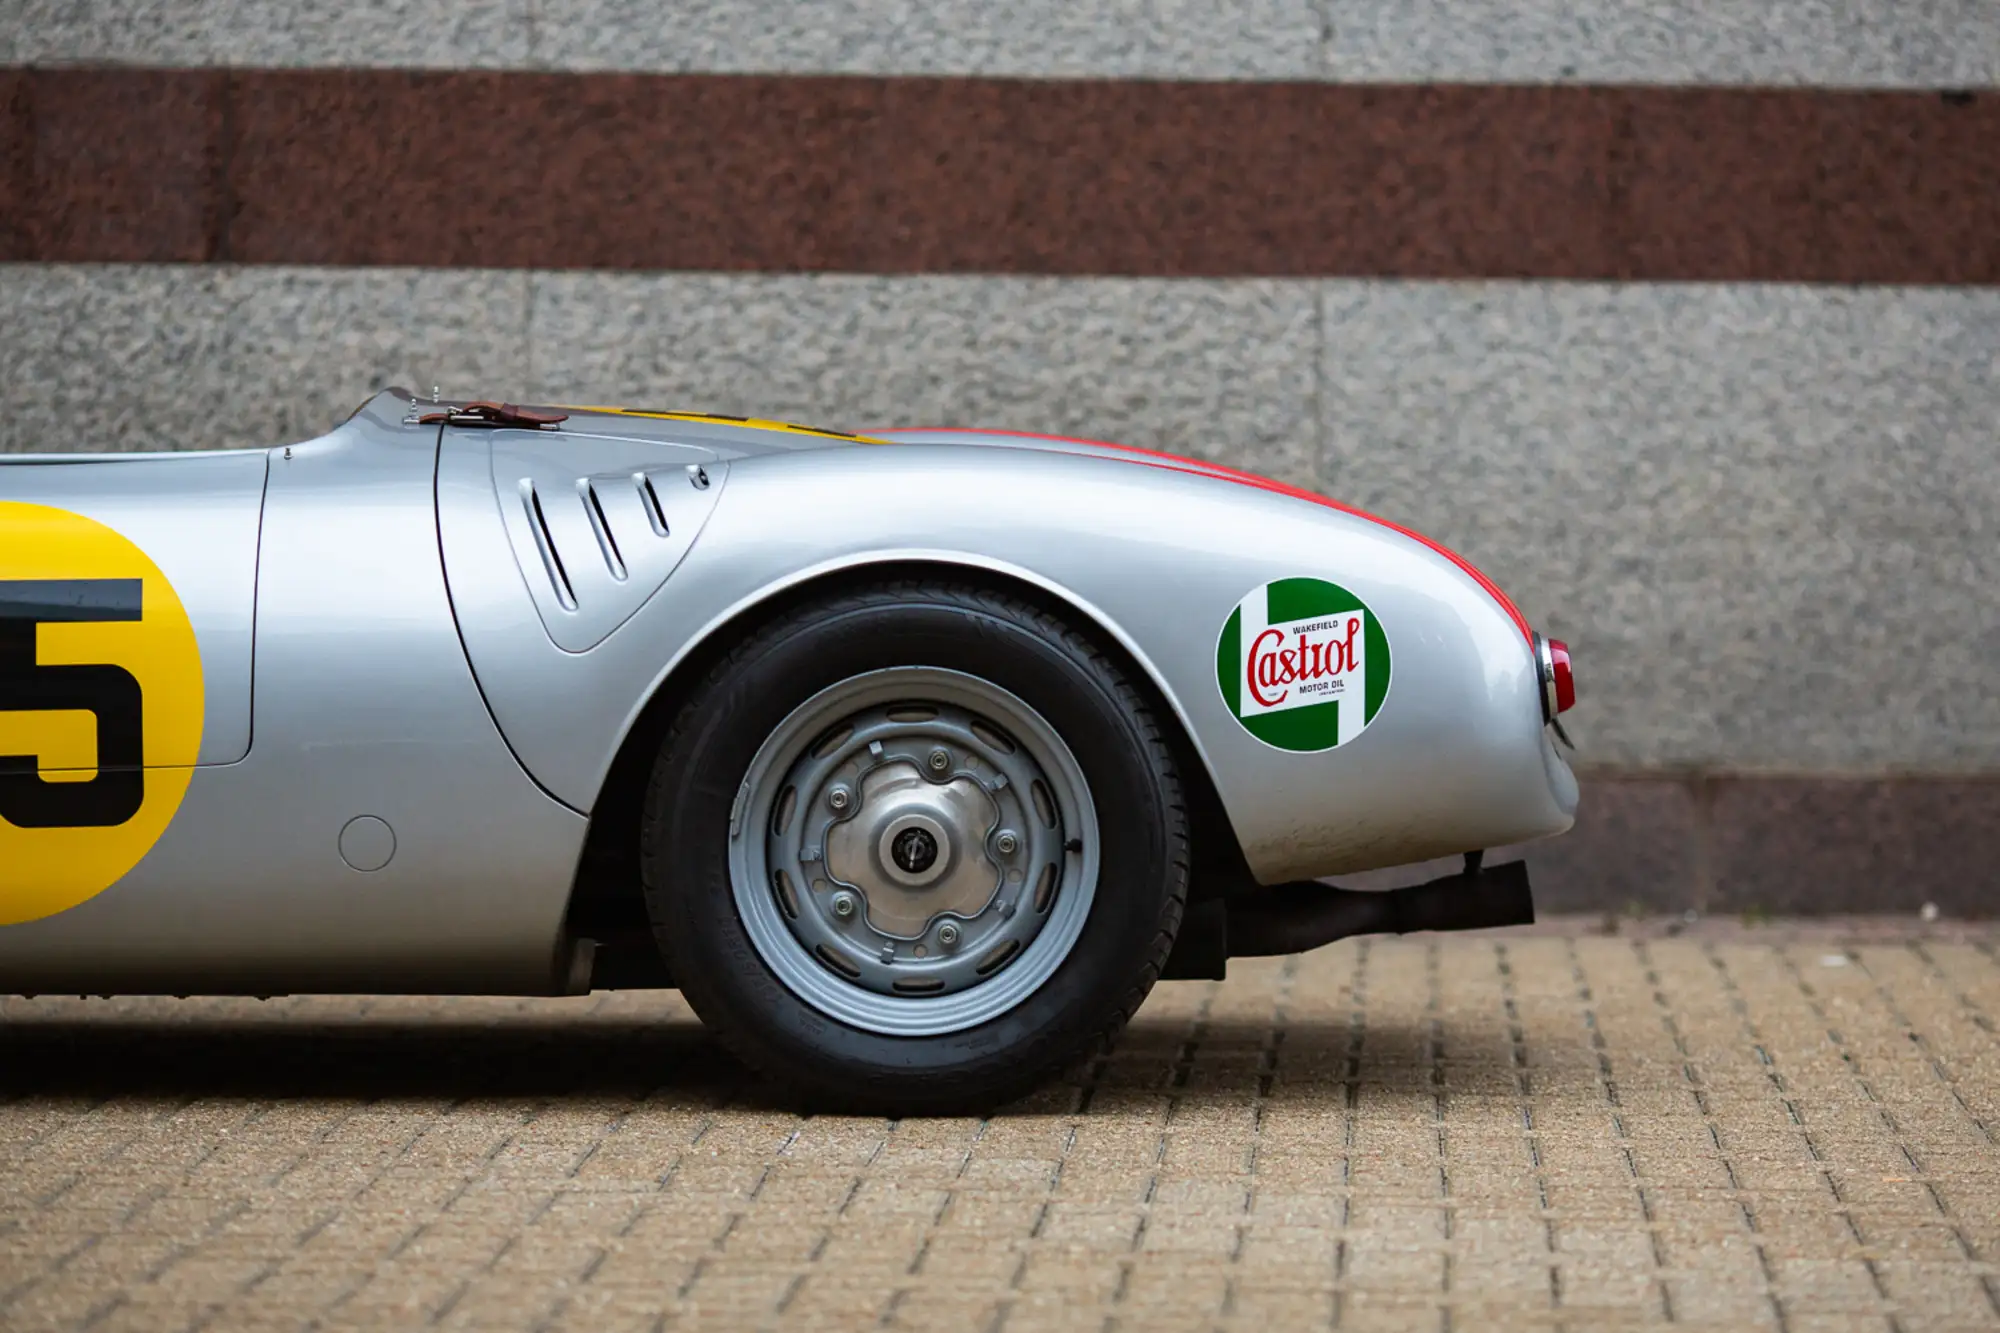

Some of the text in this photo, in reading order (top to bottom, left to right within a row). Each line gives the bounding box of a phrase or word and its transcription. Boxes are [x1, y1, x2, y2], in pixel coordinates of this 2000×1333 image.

[1293, 620, 1339, 635] WAKEFIELD
[1247, 617, 1360, 707] Castrol
[1299, 682, 1329, 694] MOTOR
[1331, 680, 1345, 690] OIL
[0, 578, 144, 828] 5
